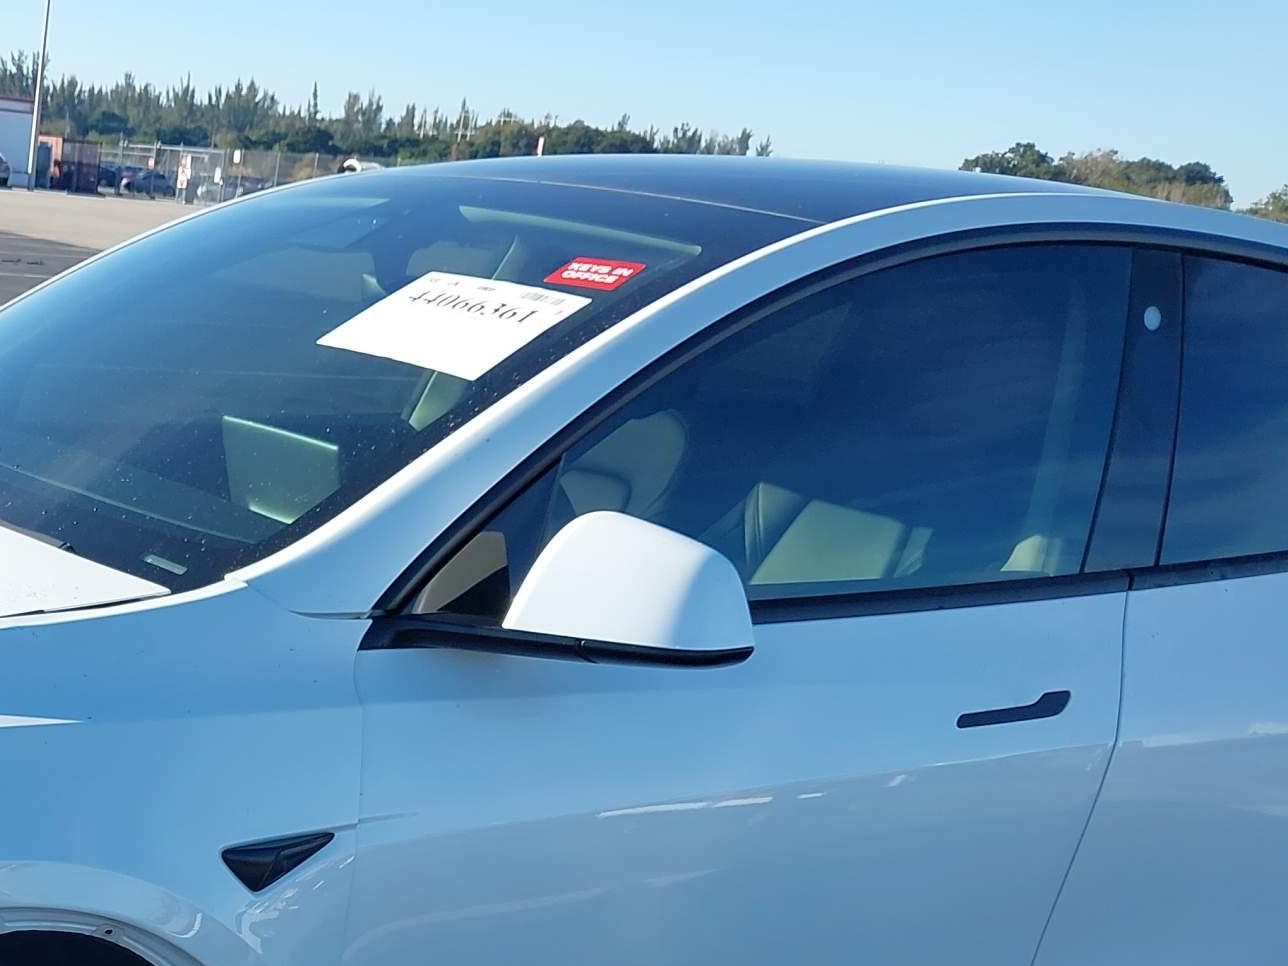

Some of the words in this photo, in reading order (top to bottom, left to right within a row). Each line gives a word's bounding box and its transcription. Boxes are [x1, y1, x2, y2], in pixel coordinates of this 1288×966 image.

[561, 270, 620, 284] OFFICE
[568, 262, 612, 273] KEYS
[612, 267, 634, 277] IN
[409, 290, 539, 323] 44066361
